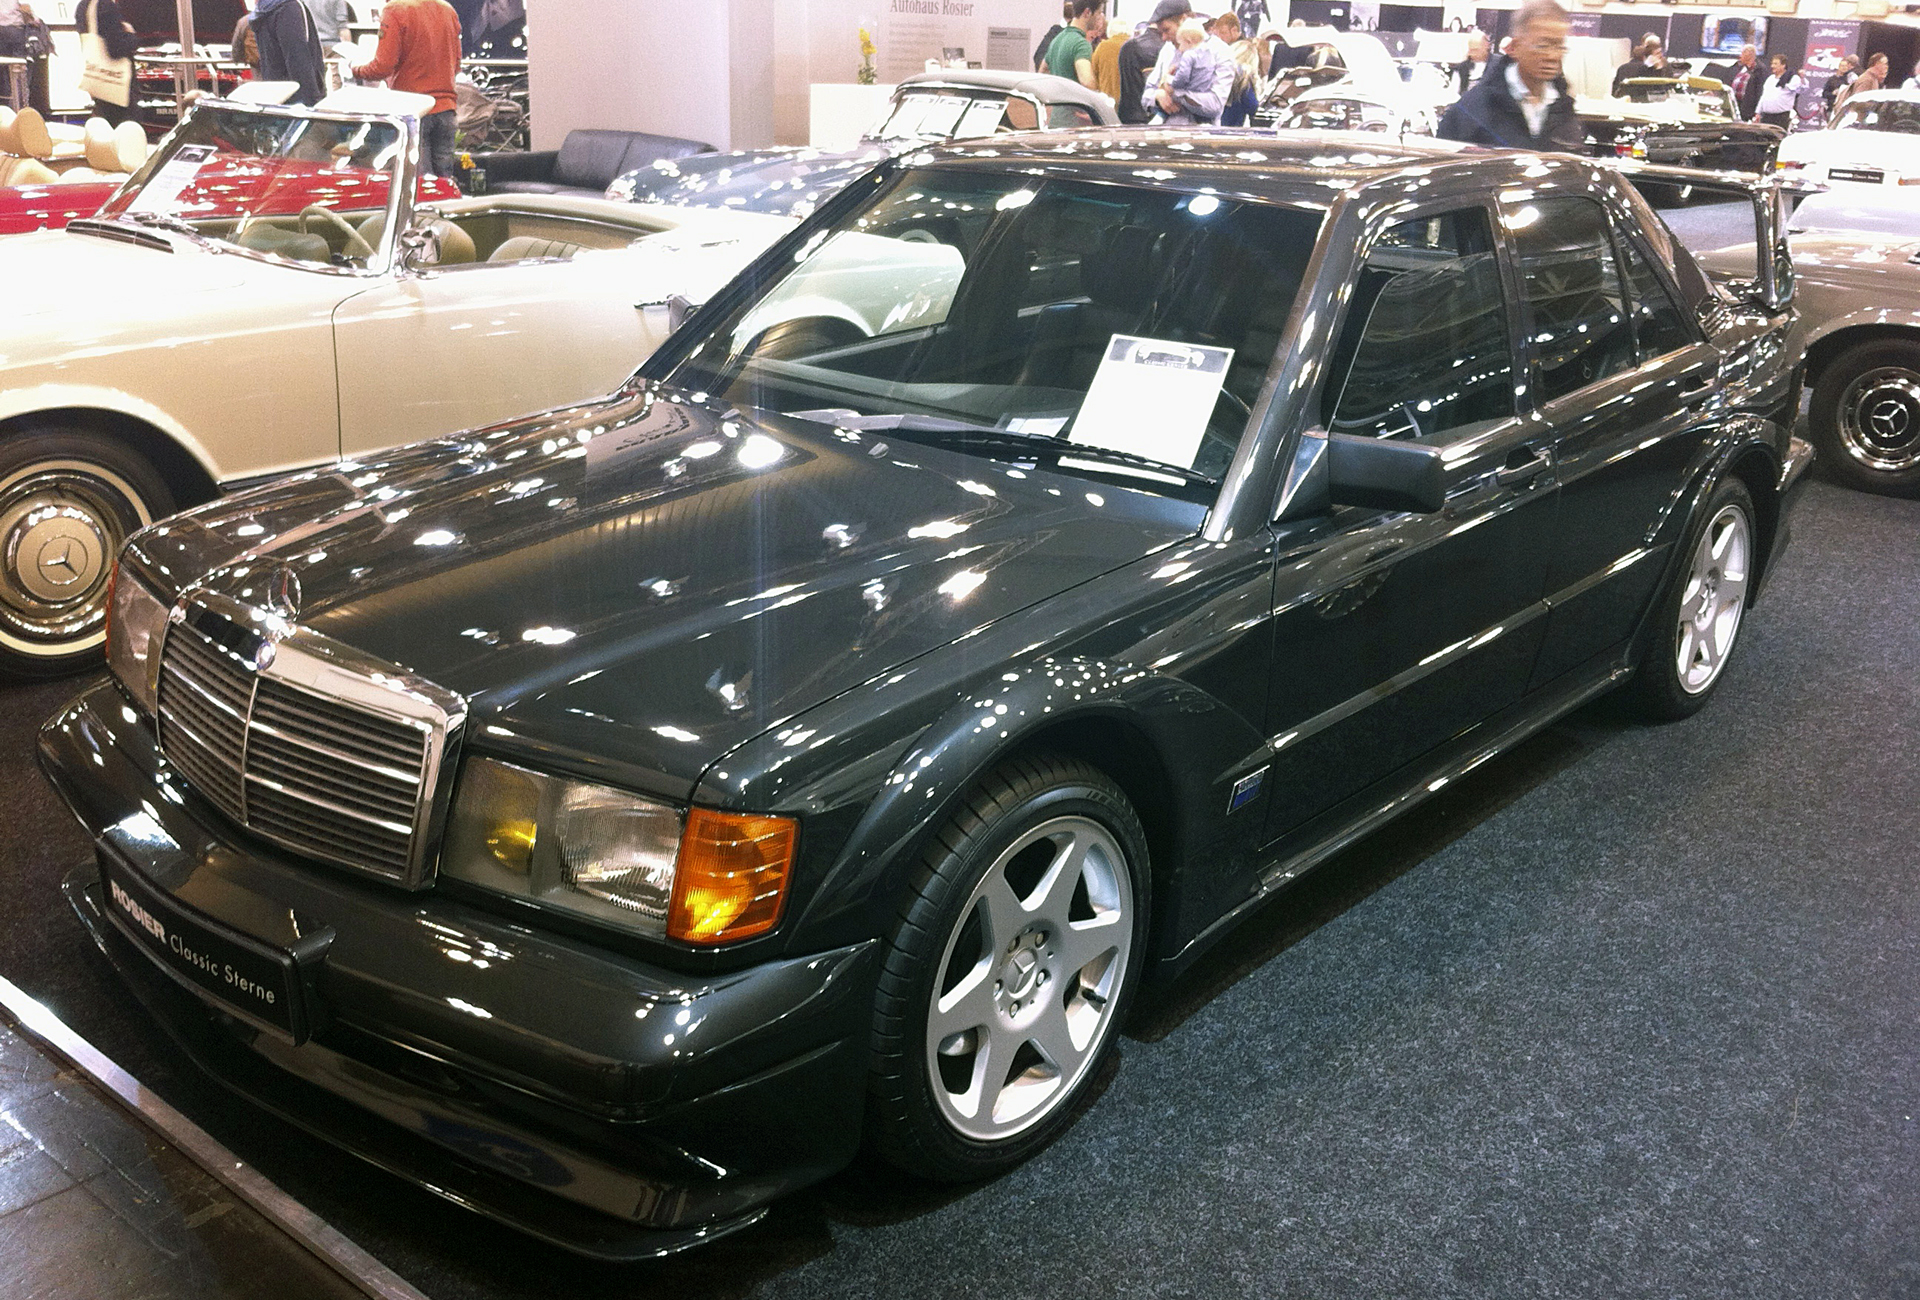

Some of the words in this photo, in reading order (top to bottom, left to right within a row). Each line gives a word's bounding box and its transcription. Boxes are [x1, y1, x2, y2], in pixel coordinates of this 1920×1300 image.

[889, 0, 940, 15] Autohaus
[942, 0, 975, 17] Rosier
[170, 934, 219, 977] Classic
[224, 964, 276, 1004] Sterne
